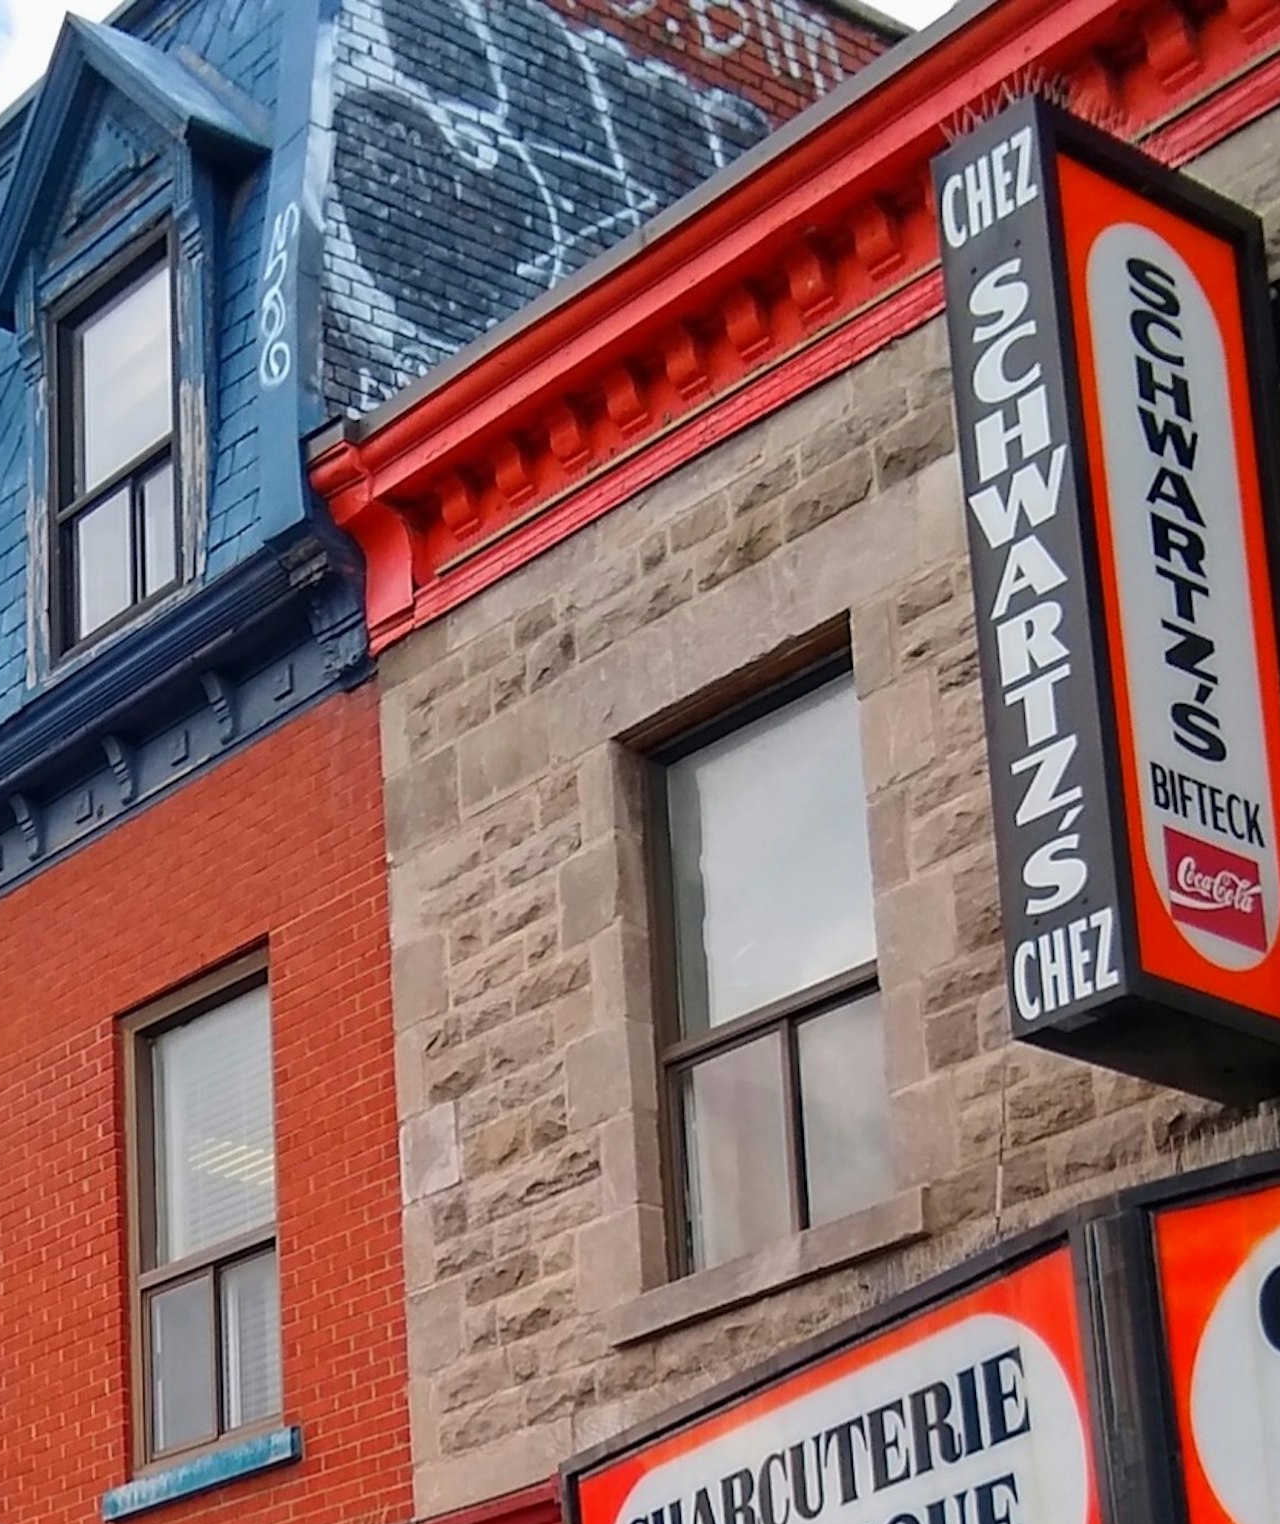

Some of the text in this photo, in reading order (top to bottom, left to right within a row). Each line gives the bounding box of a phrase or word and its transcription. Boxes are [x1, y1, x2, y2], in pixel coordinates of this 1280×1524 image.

[941, 126, 1037, 248] CHEZ
[1125, 257, 1227, 763] SCHWARTZ'S
[969, 258, 1087, 916] SCHWARTZ'S
[1150, 761, 1265, 848] BIFTECK
[1013, 907, 1119, 1022] CHEZ
